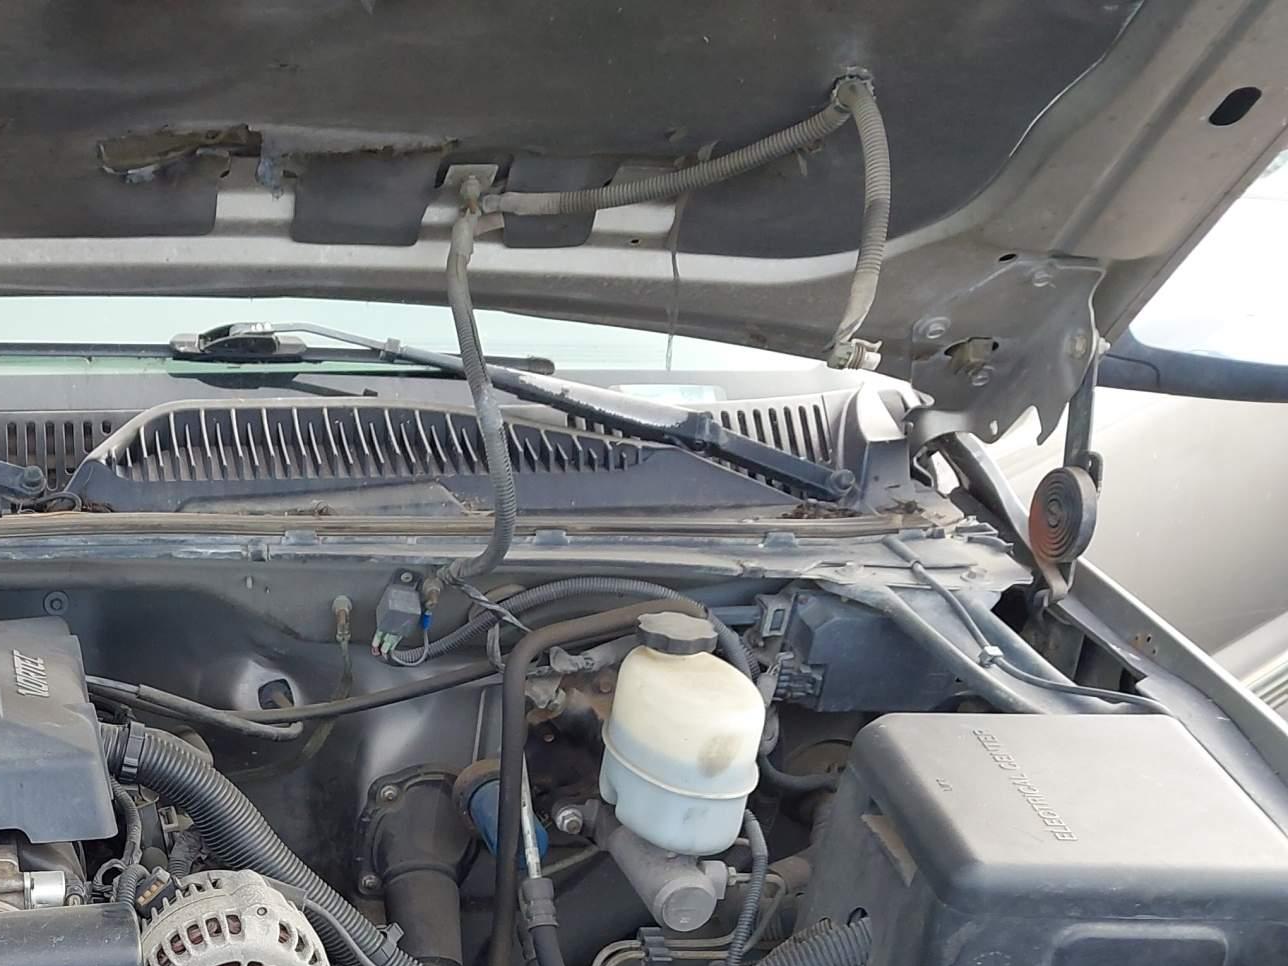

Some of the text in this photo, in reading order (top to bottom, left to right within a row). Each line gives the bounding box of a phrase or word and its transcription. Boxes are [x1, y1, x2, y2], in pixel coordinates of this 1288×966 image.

[13, 649, 50, 697] VORTEC
[972, 728, 1079, 841] ELECTRICAL CENTER
